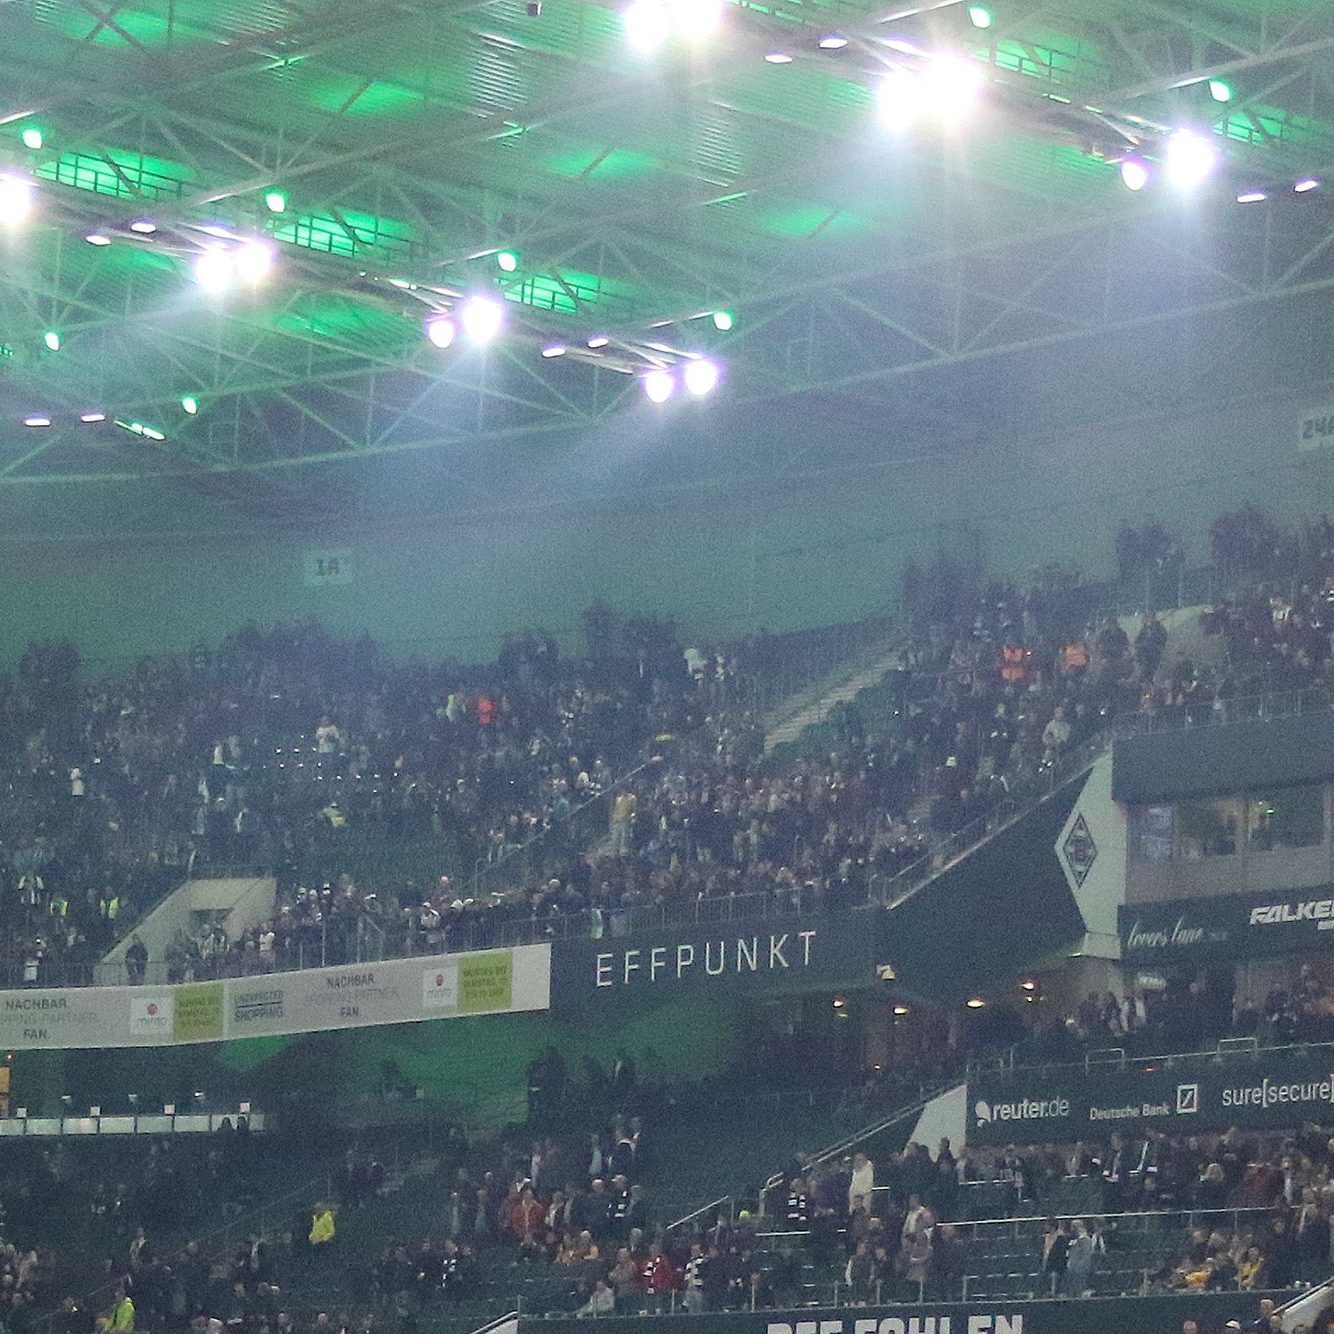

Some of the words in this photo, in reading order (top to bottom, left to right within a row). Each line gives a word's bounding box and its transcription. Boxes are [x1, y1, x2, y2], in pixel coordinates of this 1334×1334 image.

[326, 974, 374, 989] NACHBAR
[5, 998, 67, 1011] NACHBAR
[992, 1097, 1069, 1122] reuter.de
[1089, 1104, 1140, 1120] Deutsche
[1142, 1102, 1170, 1117] Bank
